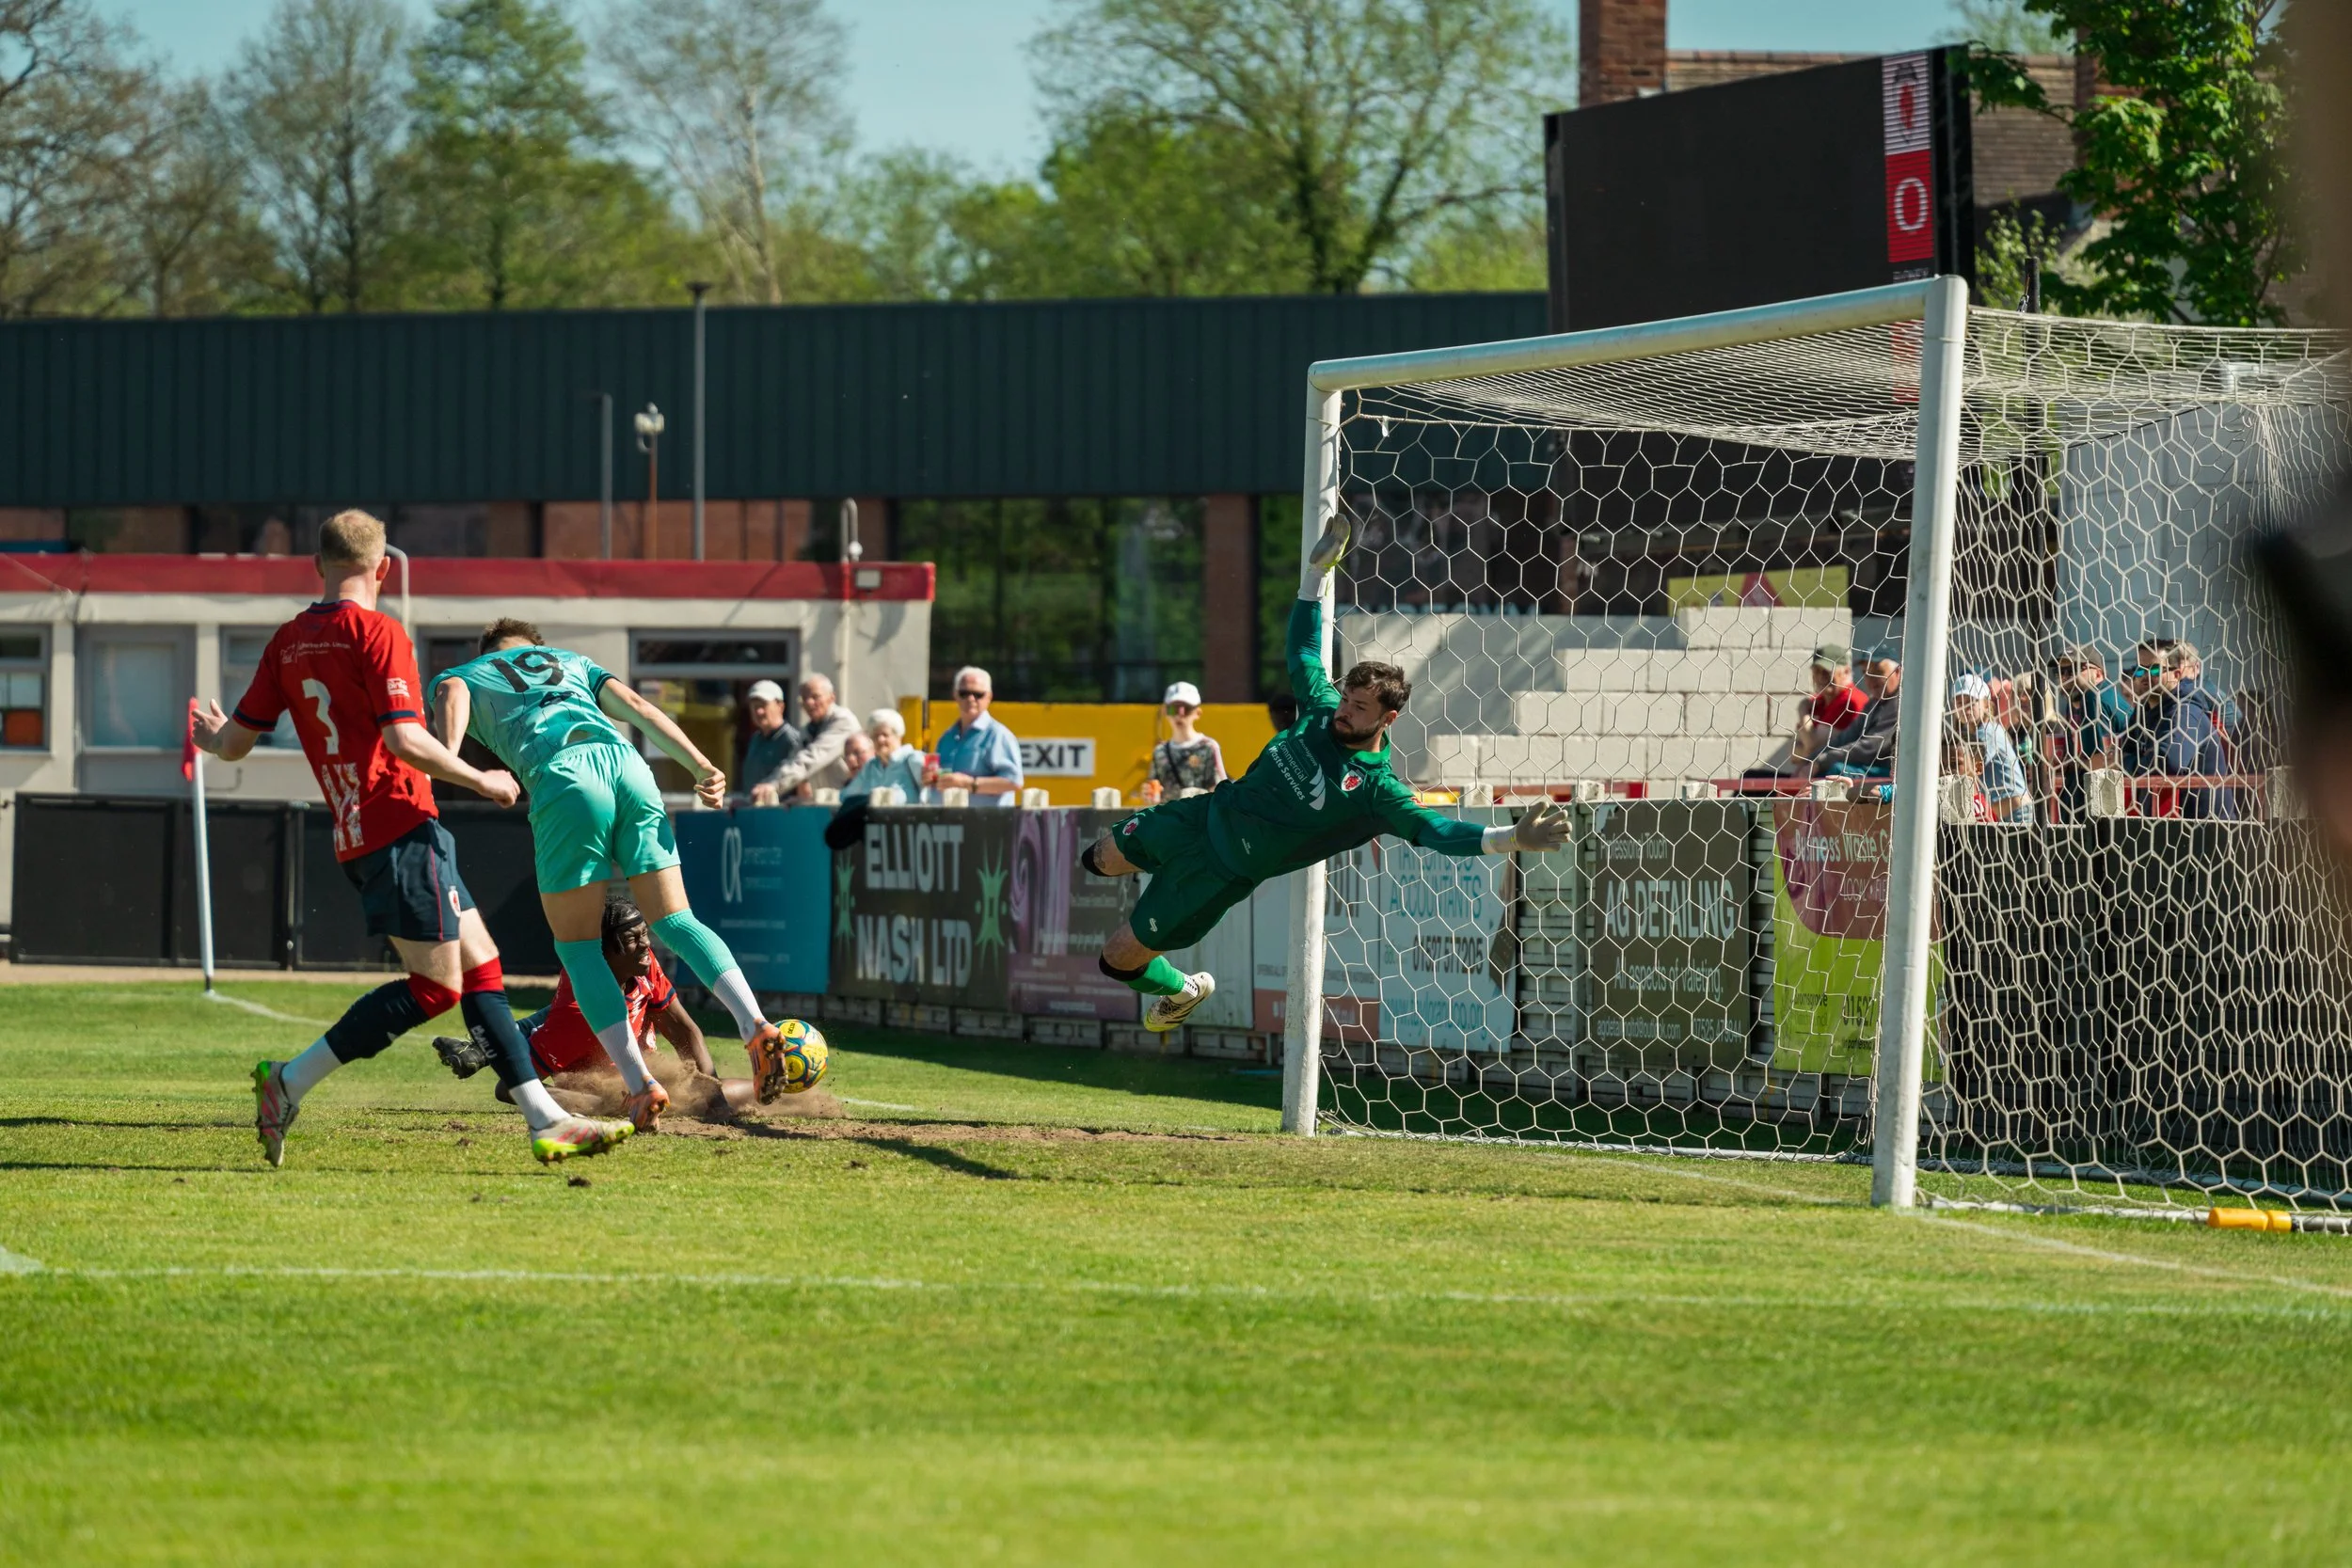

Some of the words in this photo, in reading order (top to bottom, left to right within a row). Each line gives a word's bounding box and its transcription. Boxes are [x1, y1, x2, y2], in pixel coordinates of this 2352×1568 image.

[487, 650, 564, 693] 19
[301, 678, 340, 755] 3
[1019, 743, 1087, 768] EXIT
[1268, 745, 1284, 768] Waste
[1280, 767, 1306, 800] Services
[1279, 740, 1308, 783] Commercial
[866, 822, 964, 893] ELLIOTT
[1645, 832, 1668, 859] Touch
[1795, 829, 1841, 863] Business
[1843, 829, 1877, 863] Waste
[1390, 874, 1483, 919] ACCOUNTANTS
[1605, 879, 1629, 938] AG
[1635, 879, 1735, 940] DETAILING
[857, 914, 925, 984] NASH
[931, 918, 972, 988] LTD
[1412, 935, 1442, 973] 01527
[1629, 964, 1666, 999] aspects
[1669, 957, 1678, 991] of
[1843, 995, 1875, 1027] 01527
